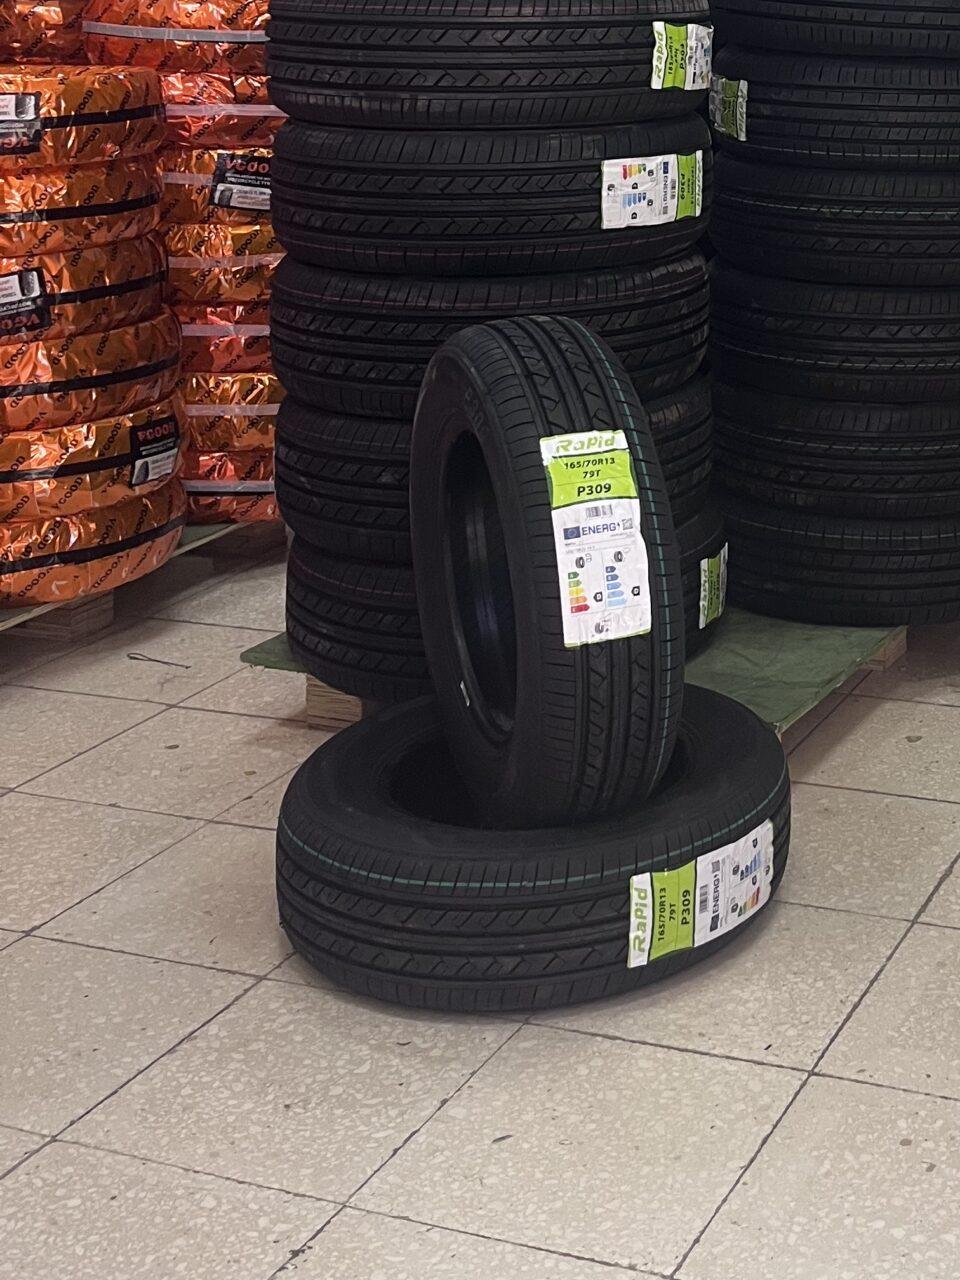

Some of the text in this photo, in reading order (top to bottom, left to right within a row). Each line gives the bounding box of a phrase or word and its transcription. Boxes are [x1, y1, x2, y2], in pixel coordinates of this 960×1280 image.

[224, 159, 270, 174] VGOO
[564, 457, 616, 470] 165/70R13
[582, 470, 601, 479] 79T
[53, 477, 83, 510] VGOOD
[577, 483, 612, 497] P309
[658, 887, 666, 942] 165/70R13
[681, 889, 690, 925] P309
